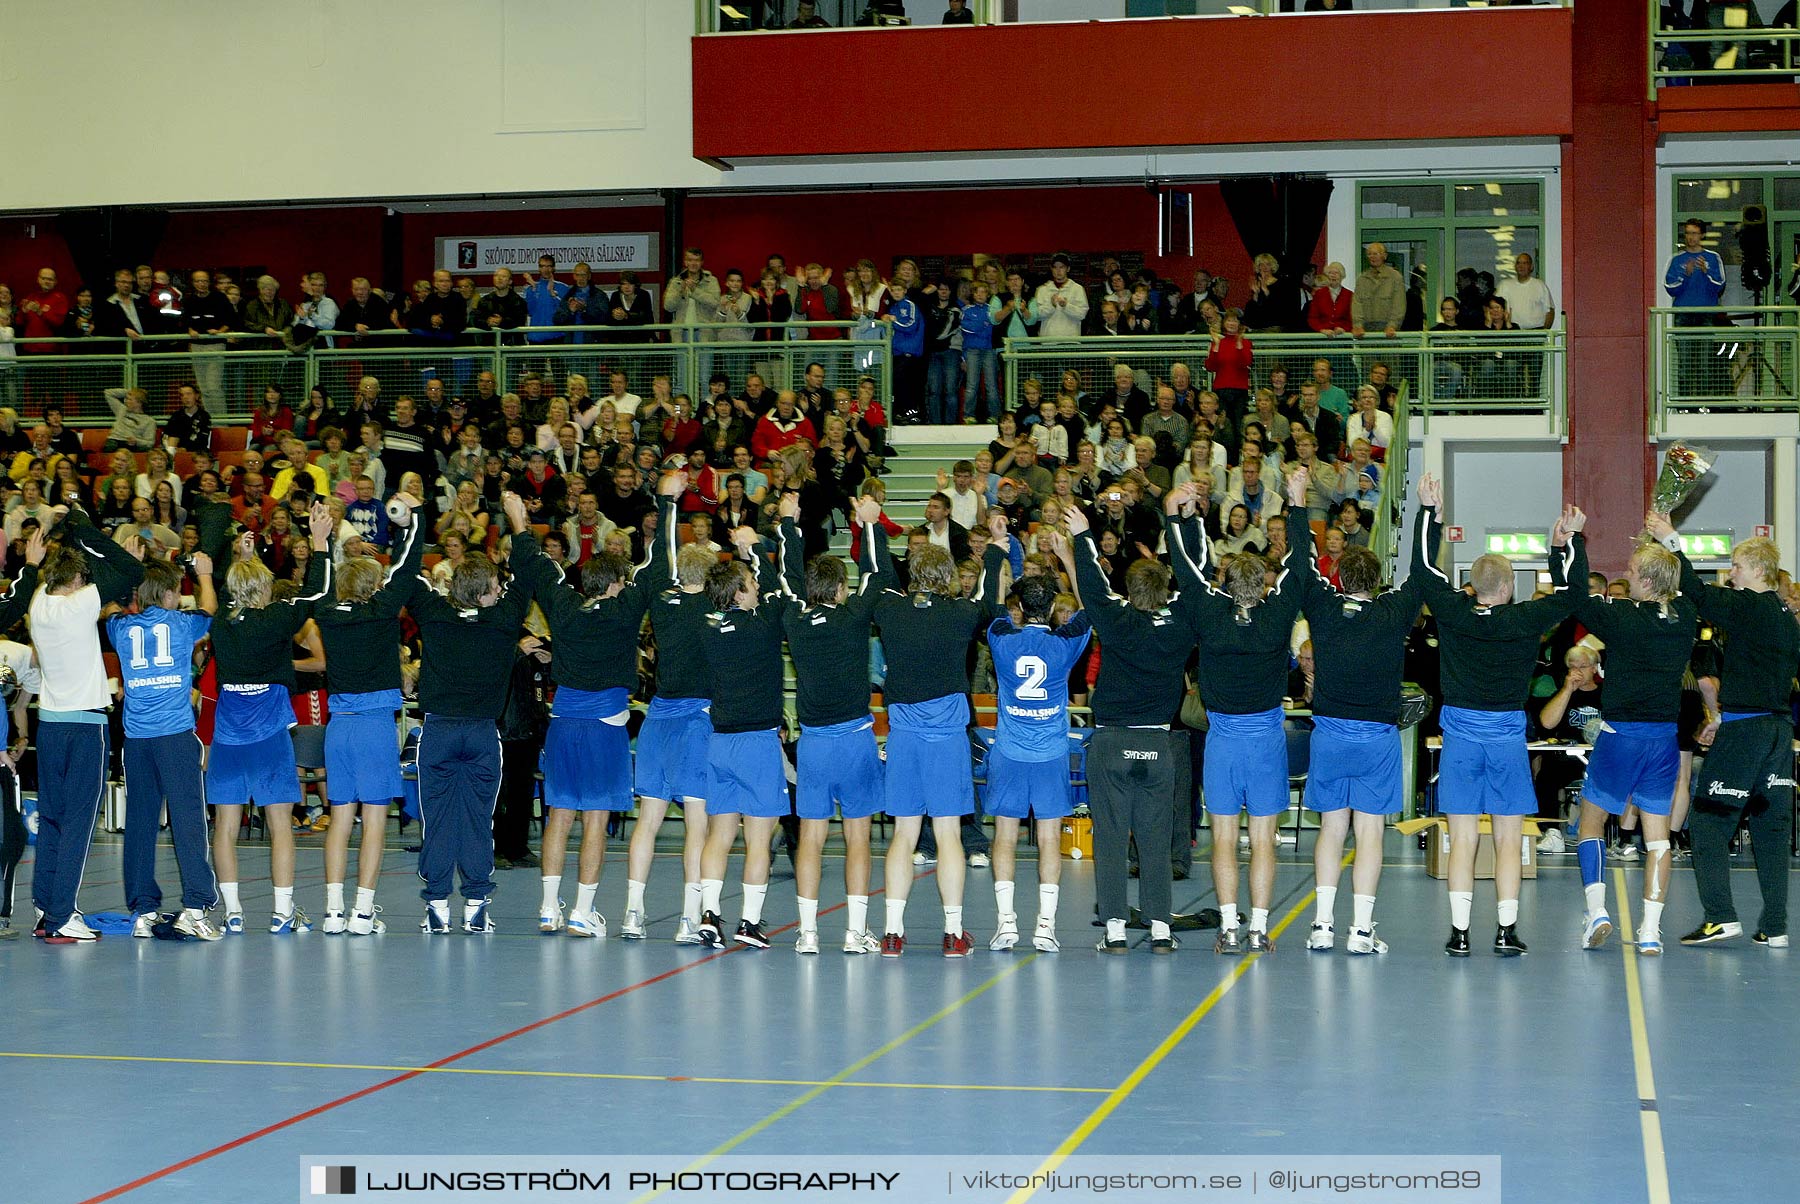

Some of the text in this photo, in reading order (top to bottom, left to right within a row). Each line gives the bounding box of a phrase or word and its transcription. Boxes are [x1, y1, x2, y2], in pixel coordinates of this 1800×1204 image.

[484, 246, 517, 265] SKÖVDE
[128, 623, 175, 670] 11
[1016, 655, 1048, 700] 2
